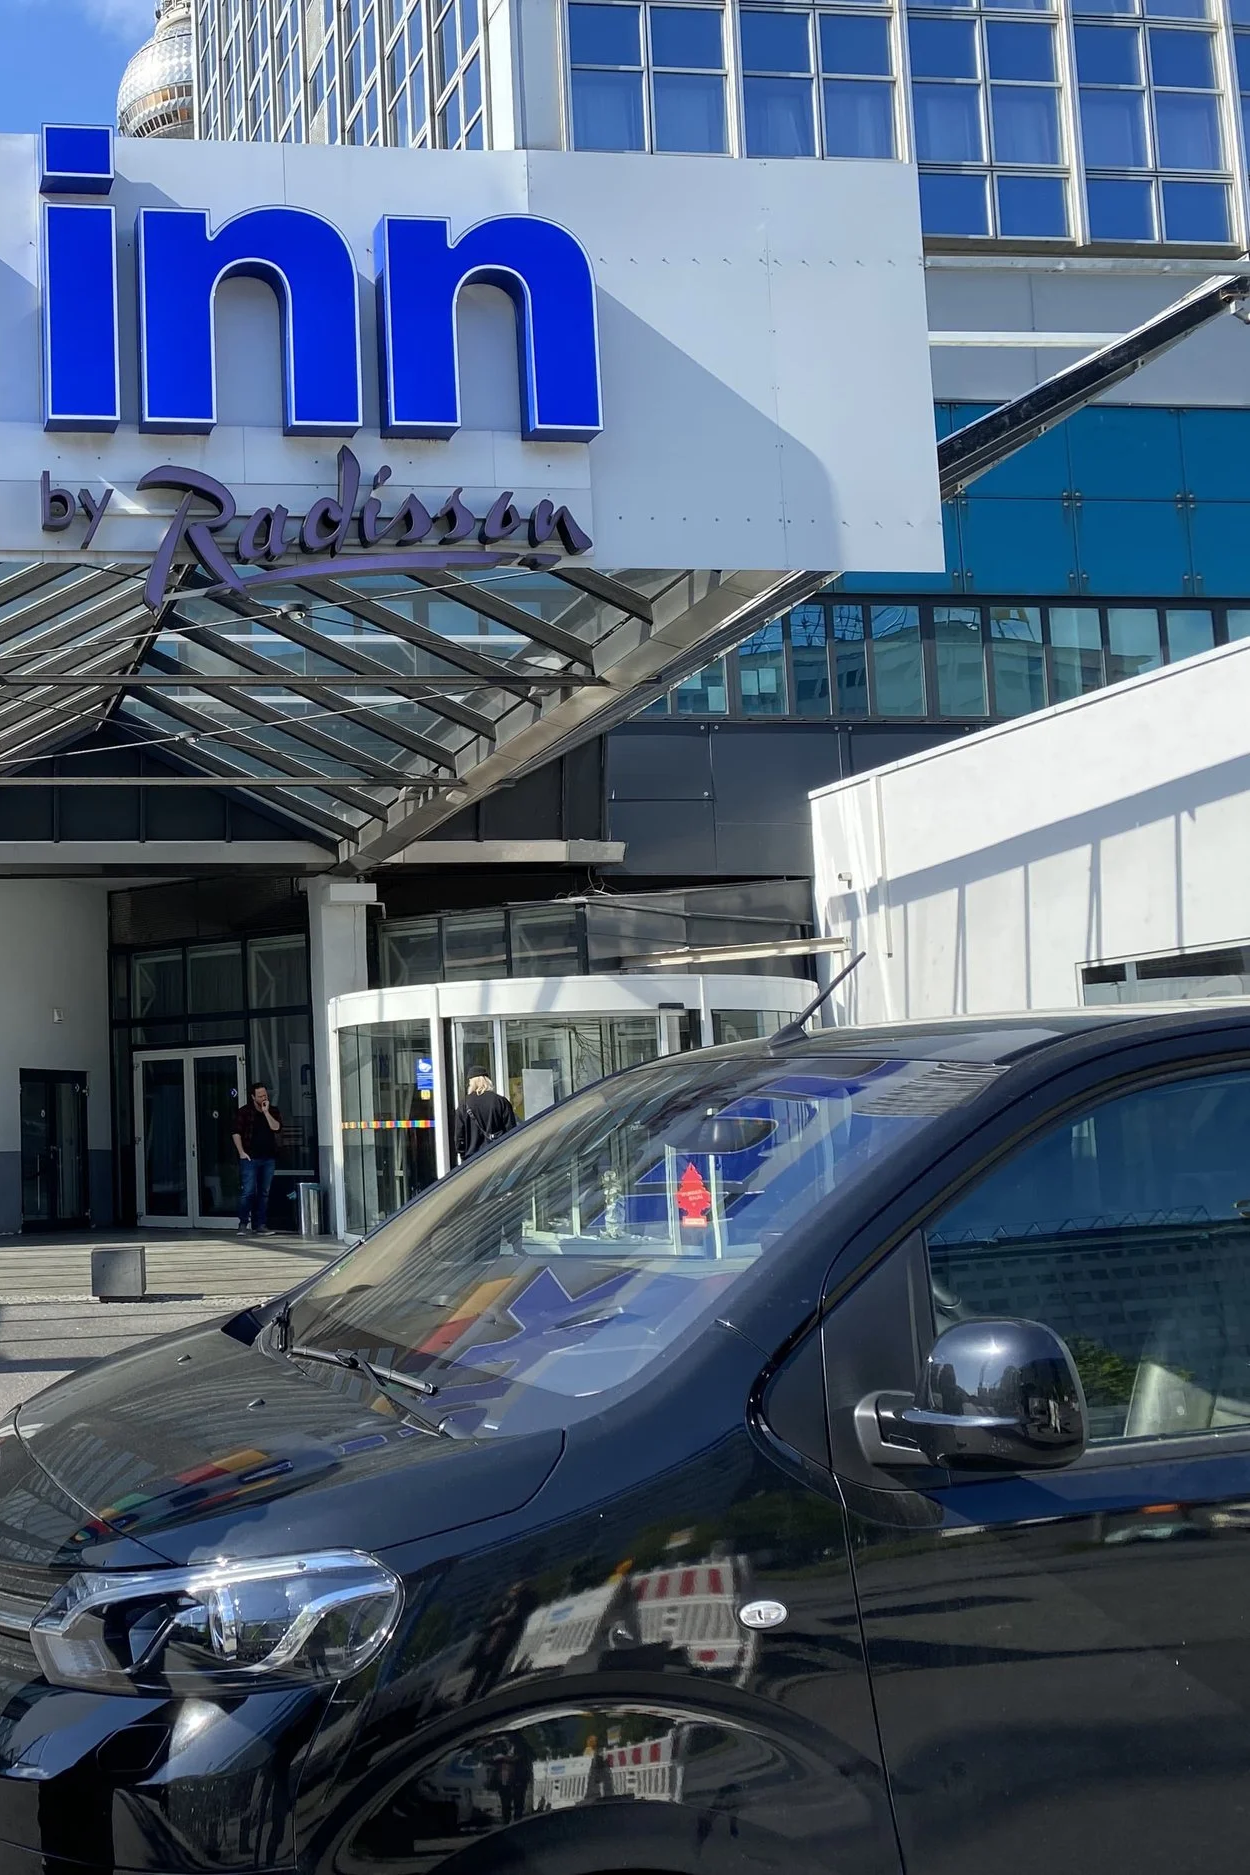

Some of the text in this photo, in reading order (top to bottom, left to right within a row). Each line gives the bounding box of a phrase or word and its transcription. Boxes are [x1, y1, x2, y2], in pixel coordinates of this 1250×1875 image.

[40, 123, 605, 441] inn
[40, 443, 594, 616] by Radisson
